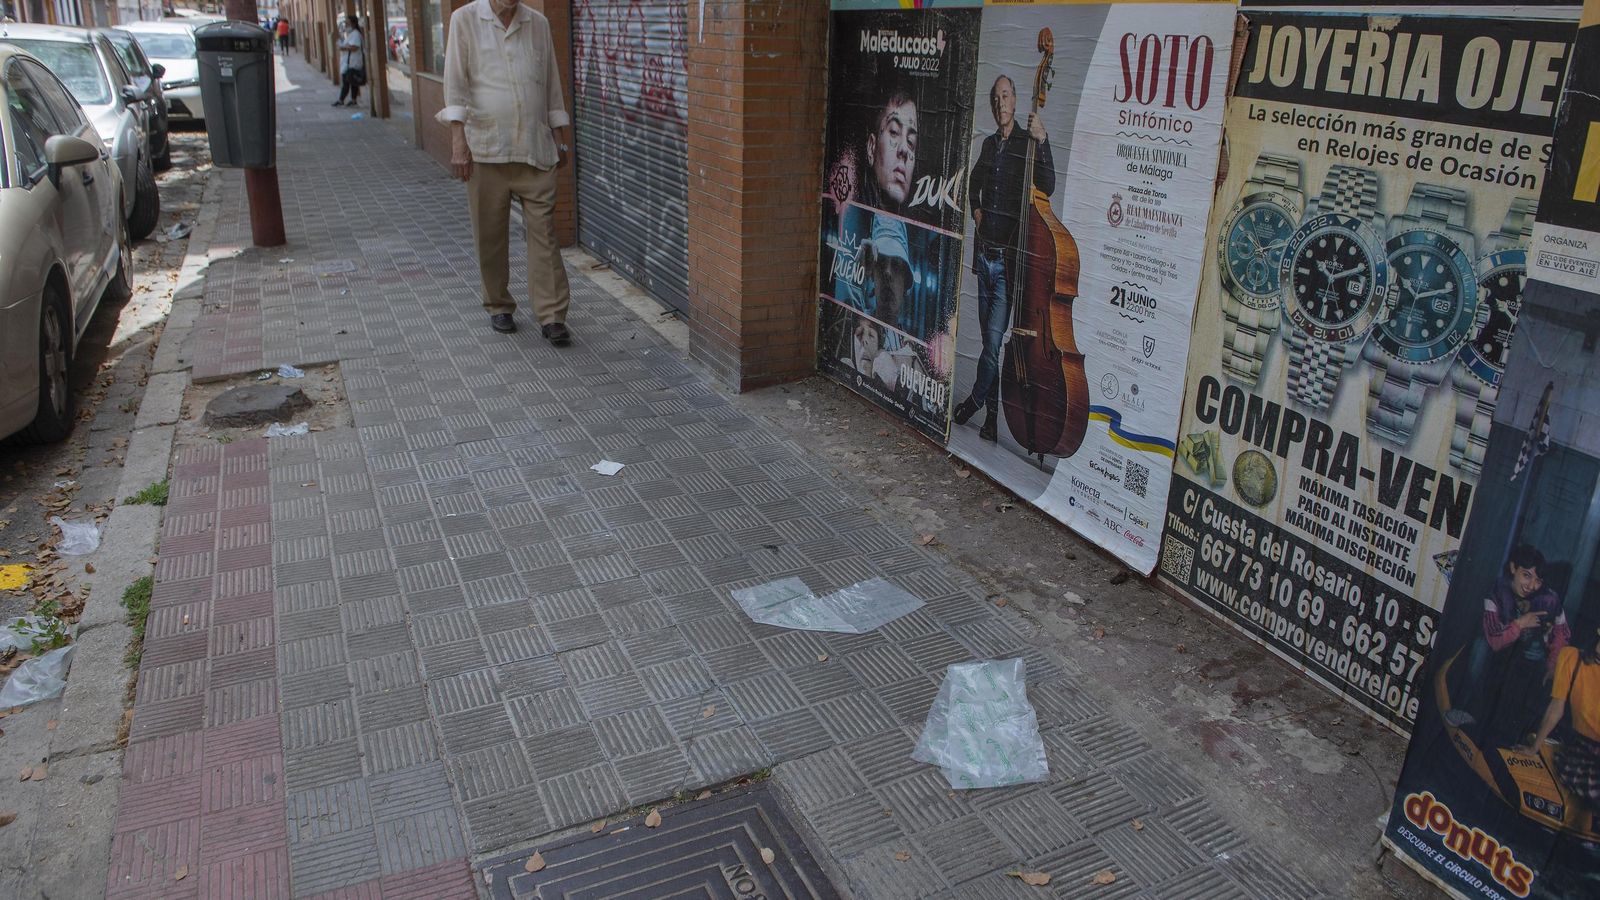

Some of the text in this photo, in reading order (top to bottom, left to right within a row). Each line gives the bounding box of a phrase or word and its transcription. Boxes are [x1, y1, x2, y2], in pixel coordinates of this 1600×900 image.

[860, 29, 937, 56] Maleducaos
[893, 55, 940, 72] 9 JULIO 2022
[1113, 32, 1214, 111] SOTO
[1248, 24, 1574, 118] JOYERIA OJE
[1118, 109, 1193, 133] Sinfónico
[1248, 104, 1266, 121] La
[1271, 108, 1357, 134] selección
[1362, 121, 1407, 141] más
[1411, 129, 1493, 155] grande
[1501, 138, 1532, 160] de
[1116, 143, 1150, 162] ORQUESTA
[1126, 162, 1173, 181] de Málaga
[1297, 137, 1537, 190] en Relojes de Ocasión
[1127, 185, 1168, 199] Plaza de Toros
[1143, 207, 1183, 227] MAESTRANZA
[1309, 216, 1328, 231] 22
[1289, 230, 1306, 250] 20
[1543, 234, 1588, 250] ORGANIZA
[826, 242, 866, 286] TRUENO
[1134, 262, 1151, 272] Banda
[1151, 266, 1159, 275] de
[1147, 256, 1168, 269] Gallego
[1281, 258, 1291, 274] 18
[1540, 253, 1558, 261] CICLO
[1568, 258, 1596, 269] EVENTOS
[1554, 261, 1576, 272] VIVO
[1578, 267, 1594, 276] AIE
[1109, 285, 1157, 310] 21 JUNIO
[1435, 300, 1450, 311] 28
[1313, 326, 1328, 340] 12
[1338, 325, 1354, 340] 10
[899, 363, 946, 411] QUEVEDO
[1071, 475, 1101, 499] Konecta
[1299, 475, 1418, 544] MÁXIMA TASACIÓN
[1103, 517, 1123, 533] ABC
[1128, 512, 1149, 529] Cajasol
[1297, 494, 1411, 563] PAGO AL INSTANTE
[1183, 488, 1201, 519] C/
[1201, 498, 1256, 549] Cuesta
[1260, 531, 1289, 567] del
[1290, 546, 1366, 616] Rosario,
[1375, 592, 1400, 627] 10
[1284, 507, 1417, 588] MÁXIMA DISCRECIÓN
[1168, 511, 1200, 543] Tlfnos.:
[1200, 533, 1236, 573] 667
[1239, 553, 1264, 591] 73
[1270, 572, 1293, 608] 10
[1297, 589, 1325, 626] 69
[1342, 615, 1387, 665] 662
[1389, 642, 1425, 683] 57
[1404, 791, 1533, 898] donuts
[1397, 826, 1437, 858] DESCUBRE
[1433, 853, 1446, 865] EL
[1444, 860, 1483, 889] CÍRCULO
